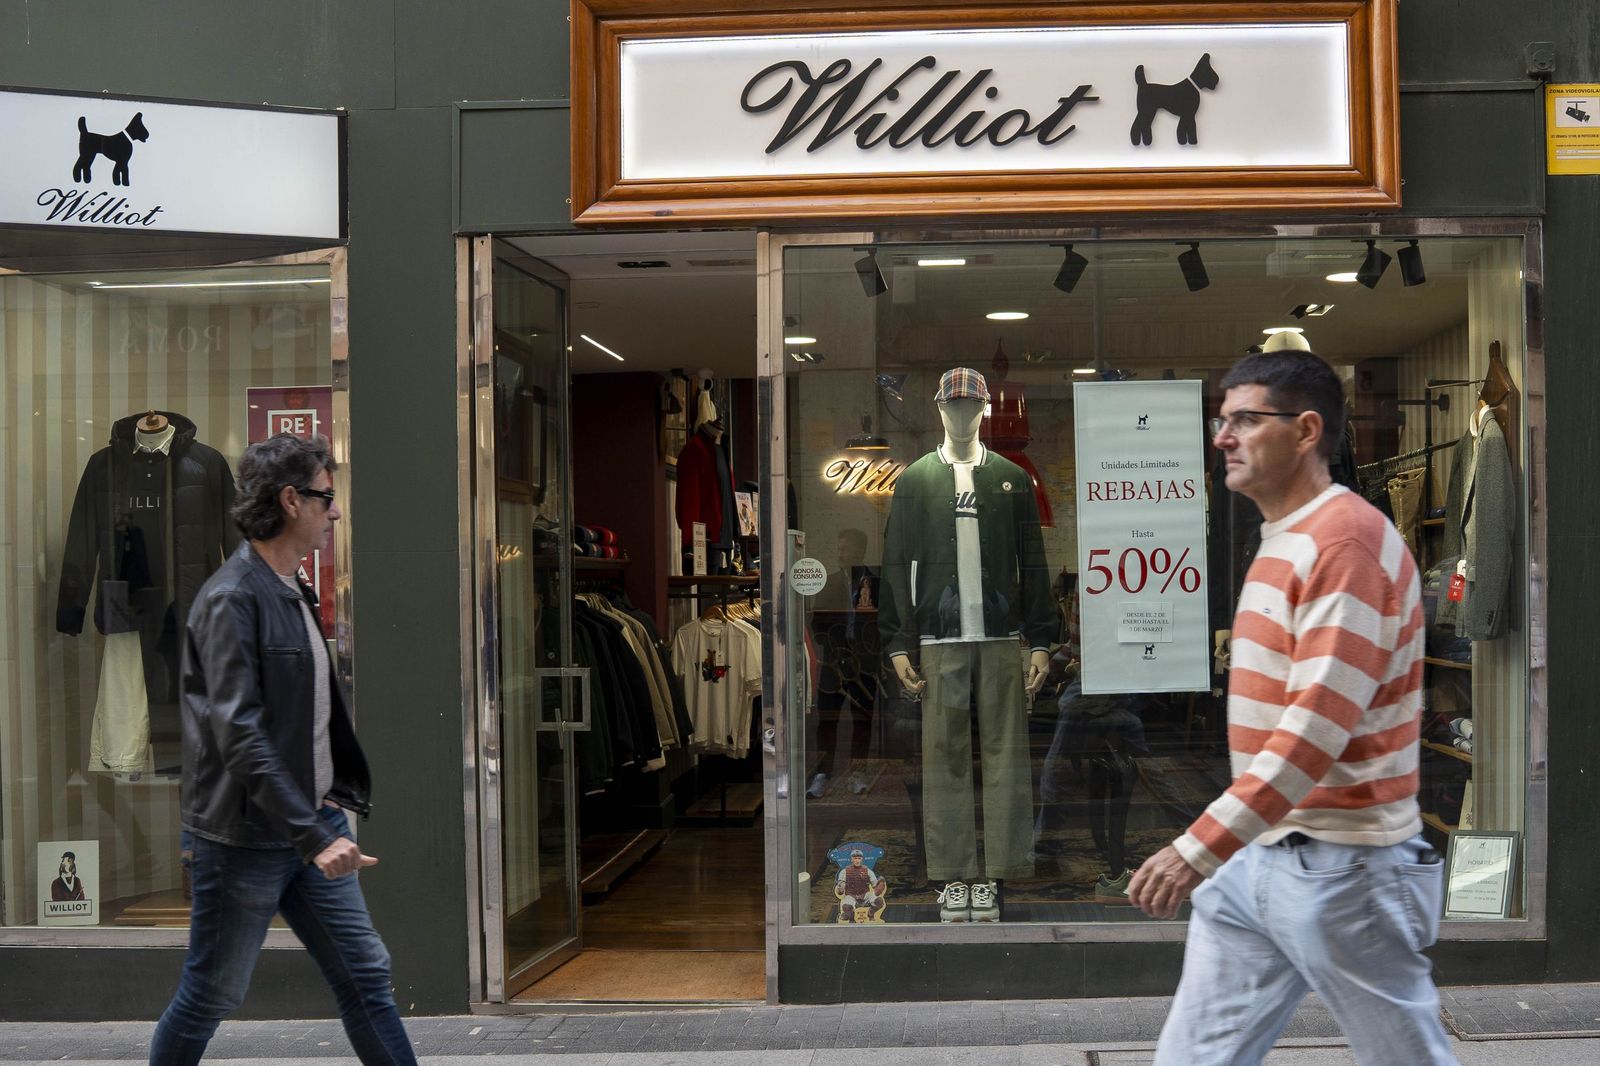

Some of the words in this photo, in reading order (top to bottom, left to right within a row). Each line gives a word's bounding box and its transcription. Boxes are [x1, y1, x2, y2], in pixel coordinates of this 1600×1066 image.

[741, 55, 1100, 154] Williot
[37, 188, 163, 227] Williot
[1101, 461, 1139, 470] Unidades
[1140, 459, 1180, 469] Limitadas
[1086, 479, 1196, 503] REBAJAS
[1131, 530, 1155, 538] Hasta
[1086, 547, 1201, 595] 50%
[49, 903, 88, 912] WILLIOT
